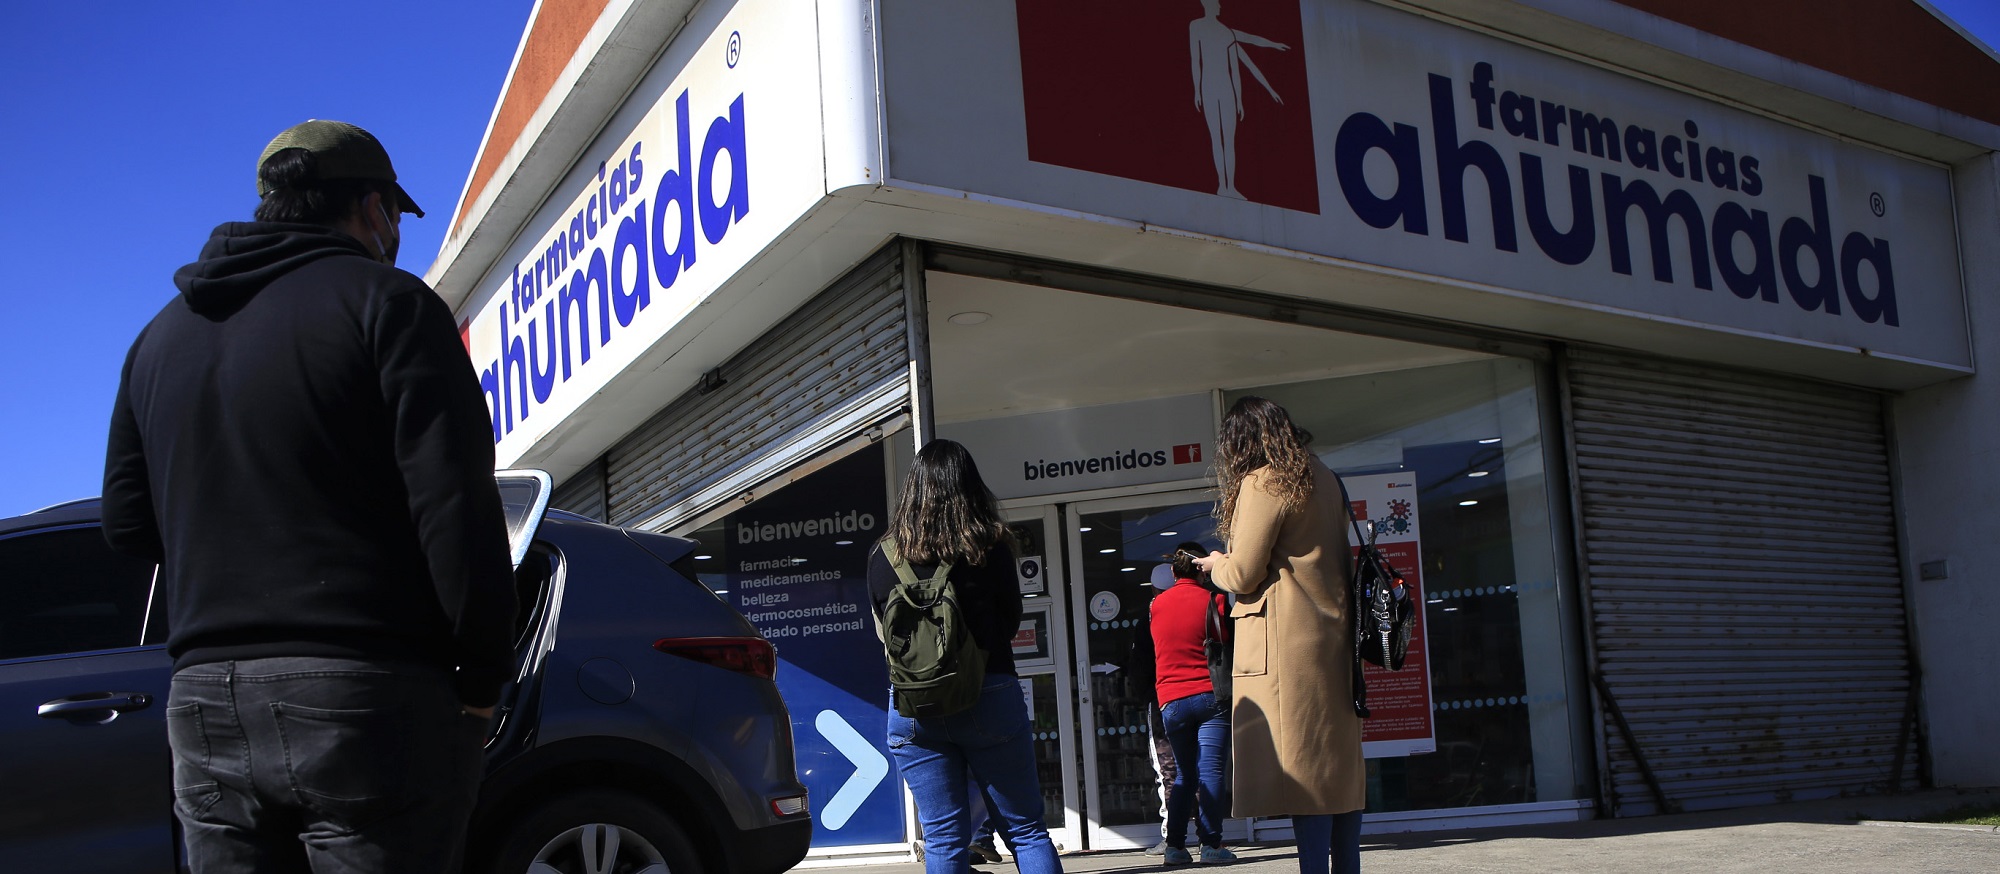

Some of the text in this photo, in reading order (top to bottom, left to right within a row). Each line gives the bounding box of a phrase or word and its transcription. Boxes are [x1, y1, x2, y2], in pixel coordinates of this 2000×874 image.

[1469, 61, 1763, 197] farmacias
[1335, 72, 1900, 328] ahumada
[511, 140, 644, 325] farmacias
[1024, 448, 1167, 481] bienvenidos
[737, 509, 875, 544] bienvenido
[740, 556, 800, 572] farmacia
[740, 569, 842, 590] medicamentos
[741, 593, 789, 606] belleza
[760, 618, 864, 639] idado personal
